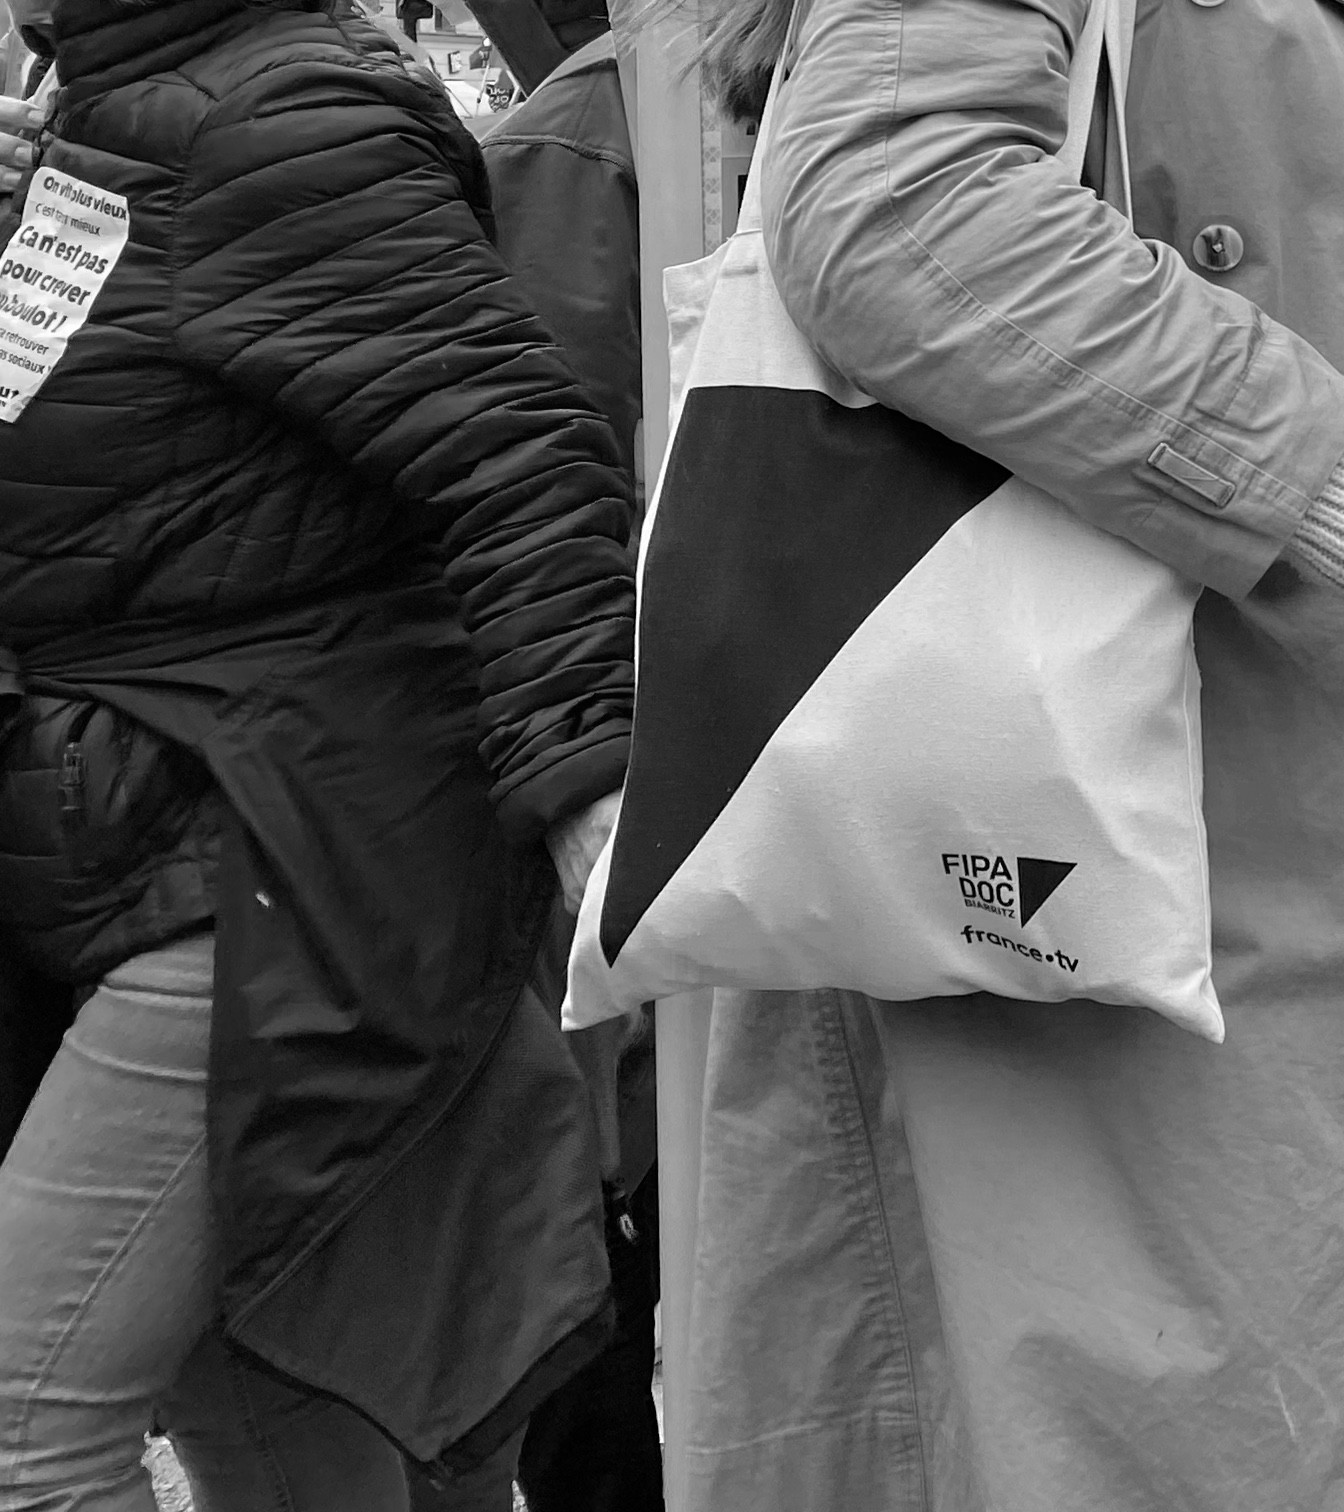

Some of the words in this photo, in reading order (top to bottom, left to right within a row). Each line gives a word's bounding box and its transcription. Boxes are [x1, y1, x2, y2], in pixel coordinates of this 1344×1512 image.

[43, 176, 60, 192] On
[38, 234, 82, 263] n'est
[73, 250, 109, 274] pas
[0, 259, 43, 286] pour
[39, 274, 91, 306] crever
[6, 331, 49, 355] retrouver
[8, 352, 46, 375] sociaux
[941, 853, 1013, 881] FIPA
[959, 877, 1015, 908] DOC
[964, 899, 1016, 919] BIARRITZ
